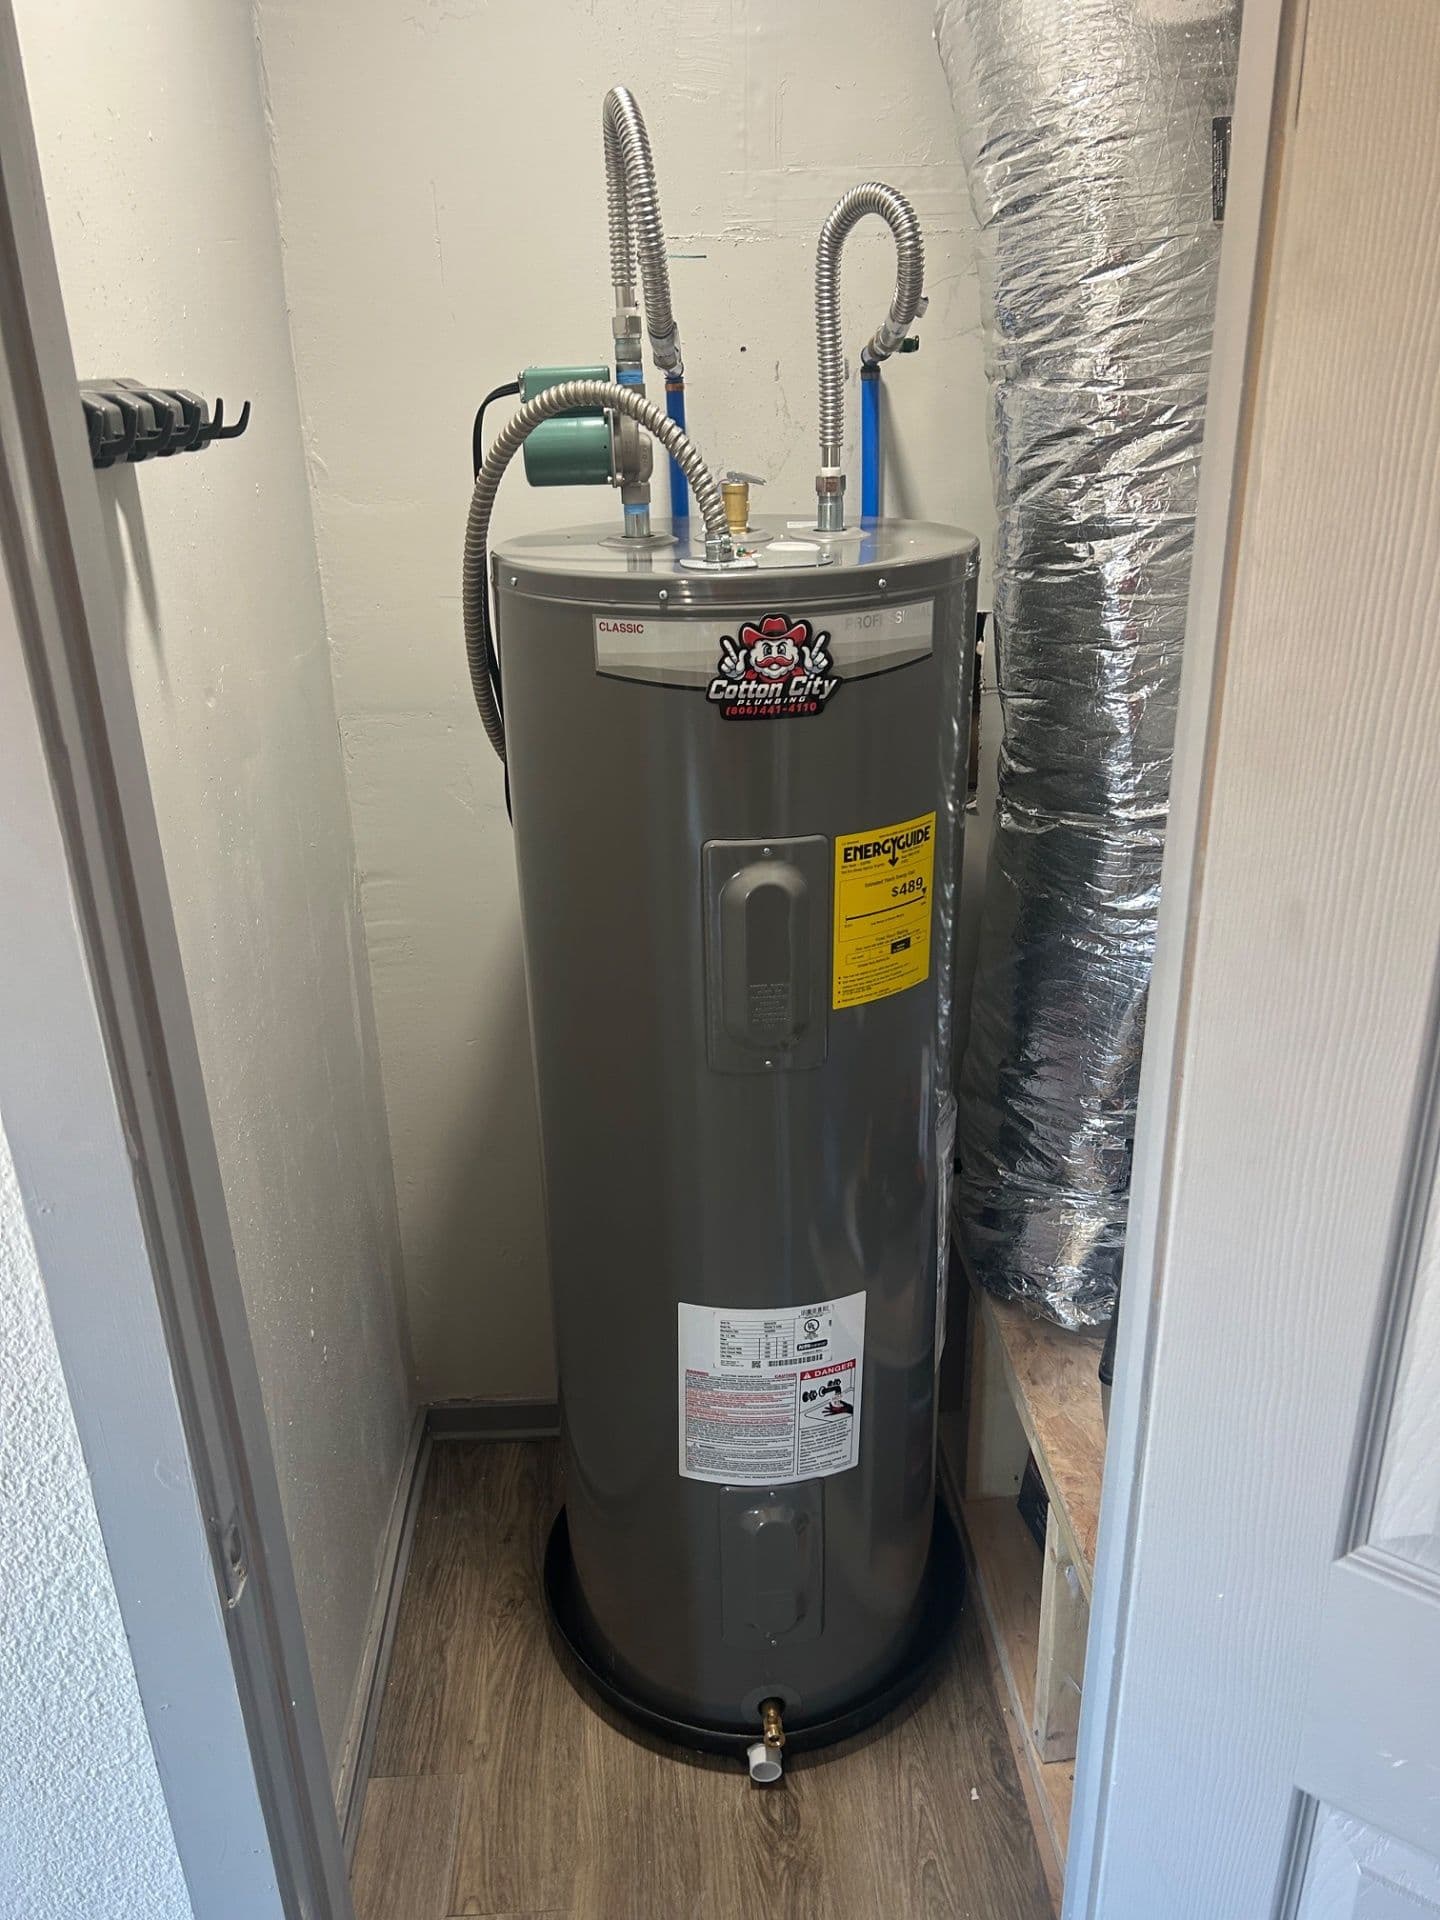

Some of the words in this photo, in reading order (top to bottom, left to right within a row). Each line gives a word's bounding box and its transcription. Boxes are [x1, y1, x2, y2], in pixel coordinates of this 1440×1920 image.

[599, 621, 644, 634] CLASSIC
[708, 679, 783, 699] Cotton
[788, 673, 837, 699] City
[737, 696, 807, 706] PLUMBING
[843, 825, 931, 864] ENERGYGUIDE
[891, 876, 923, 897] $489
[814, 1361, 853, 1377] DANGER
